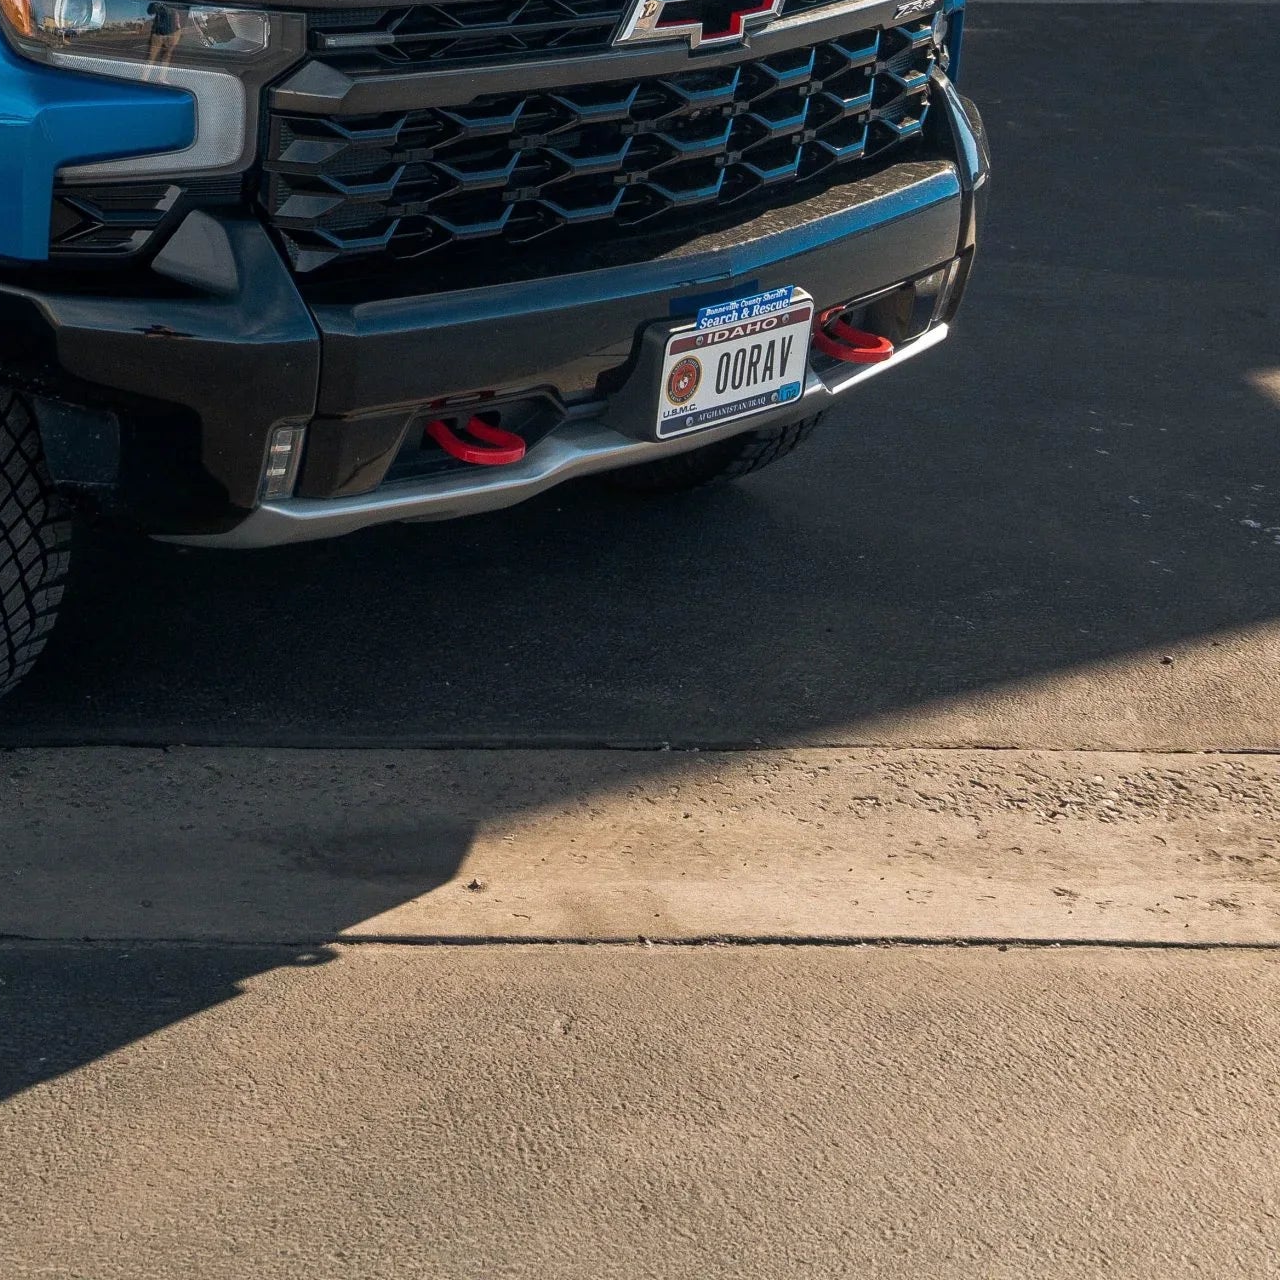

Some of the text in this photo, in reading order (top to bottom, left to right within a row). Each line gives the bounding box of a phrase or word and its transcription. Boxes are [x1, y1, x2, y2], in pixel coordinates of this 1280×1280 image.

[699, 297, 789, 329] Search & Rescue
[740, 296, 762, 308] County
[707, 317, 778, 343] IDAHO
